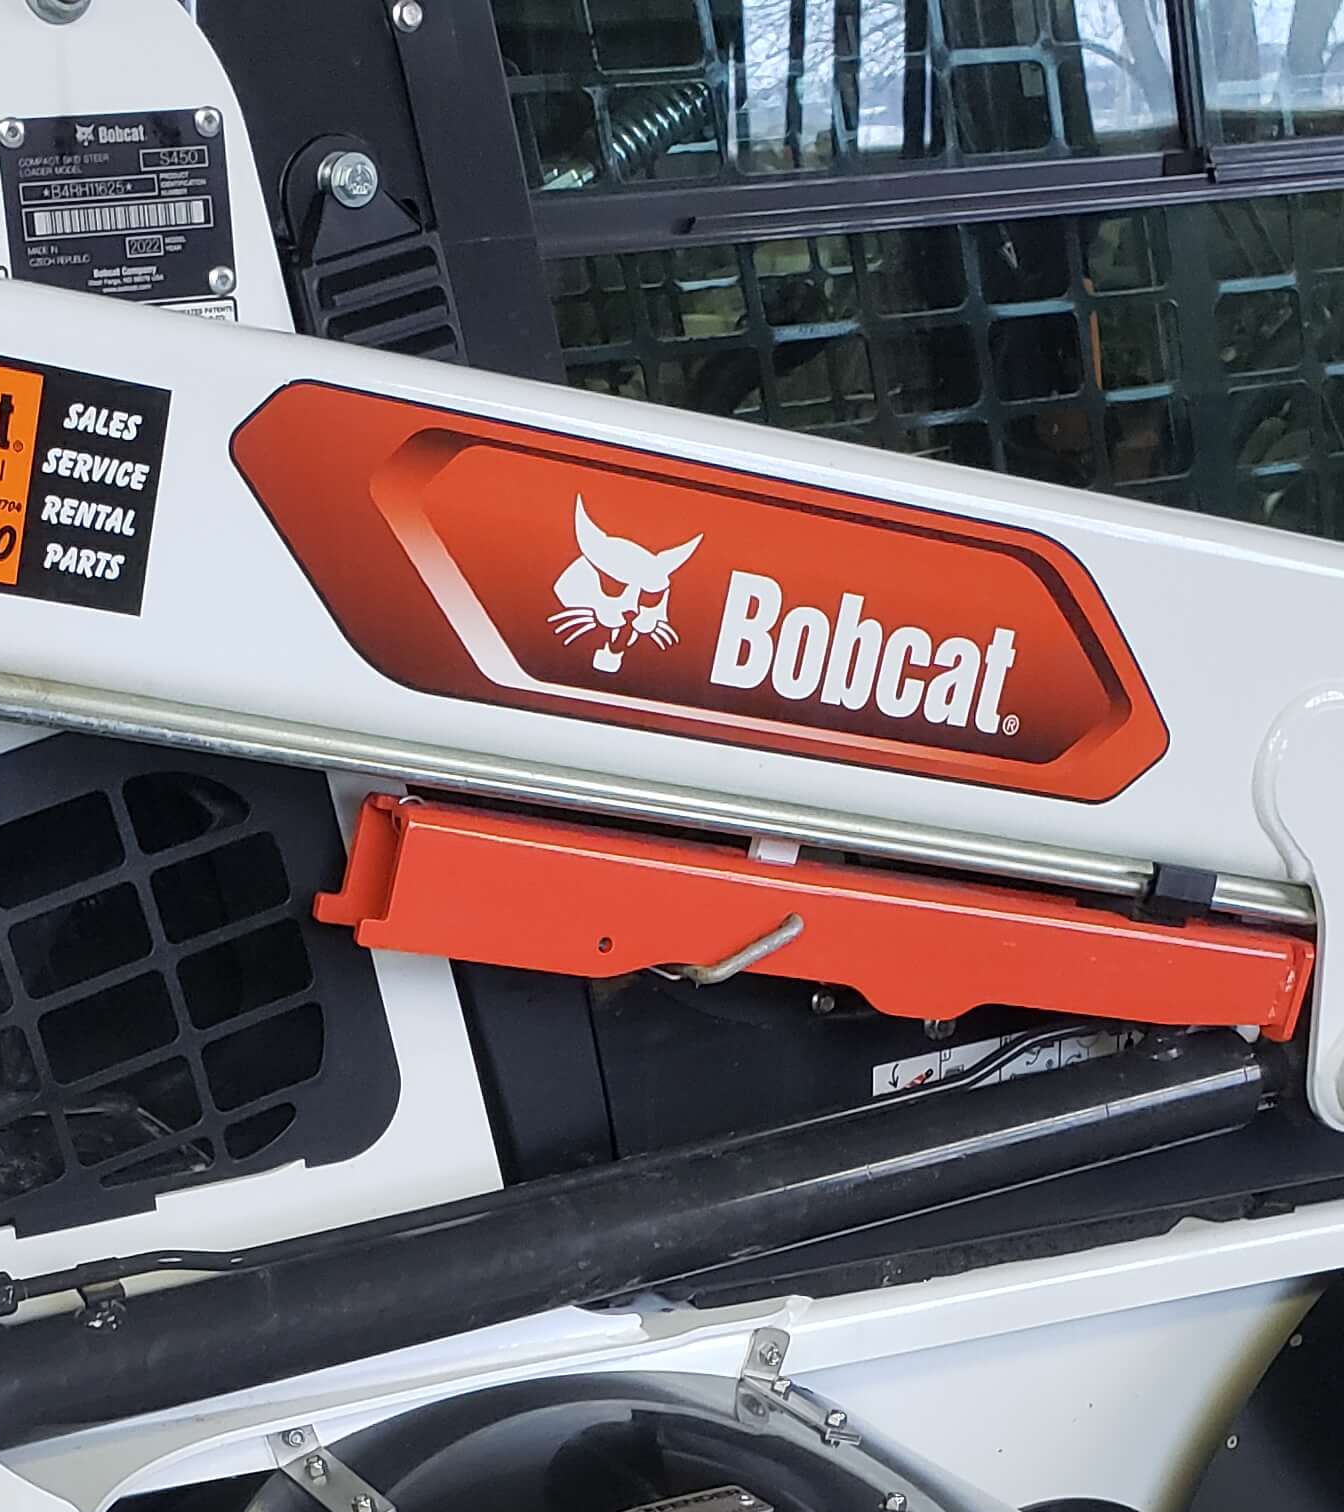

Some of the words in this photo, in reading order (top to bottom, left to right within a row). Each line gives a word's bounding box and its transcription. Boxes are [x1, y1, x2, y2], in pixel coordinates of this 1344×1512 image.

[98, 124, 145, 144] Bobcat
[159, 150, 199, 166] S450
[129, 239, 161, 254] 2022
[63, 402, 143, 442] SALES
[41, 447, 150, 491] SERVICE
[40, 494, 137, 537] RENTAL
[43, 543, 126, 581] PARTS
[710, 569, 1016, 735] Bobcat
